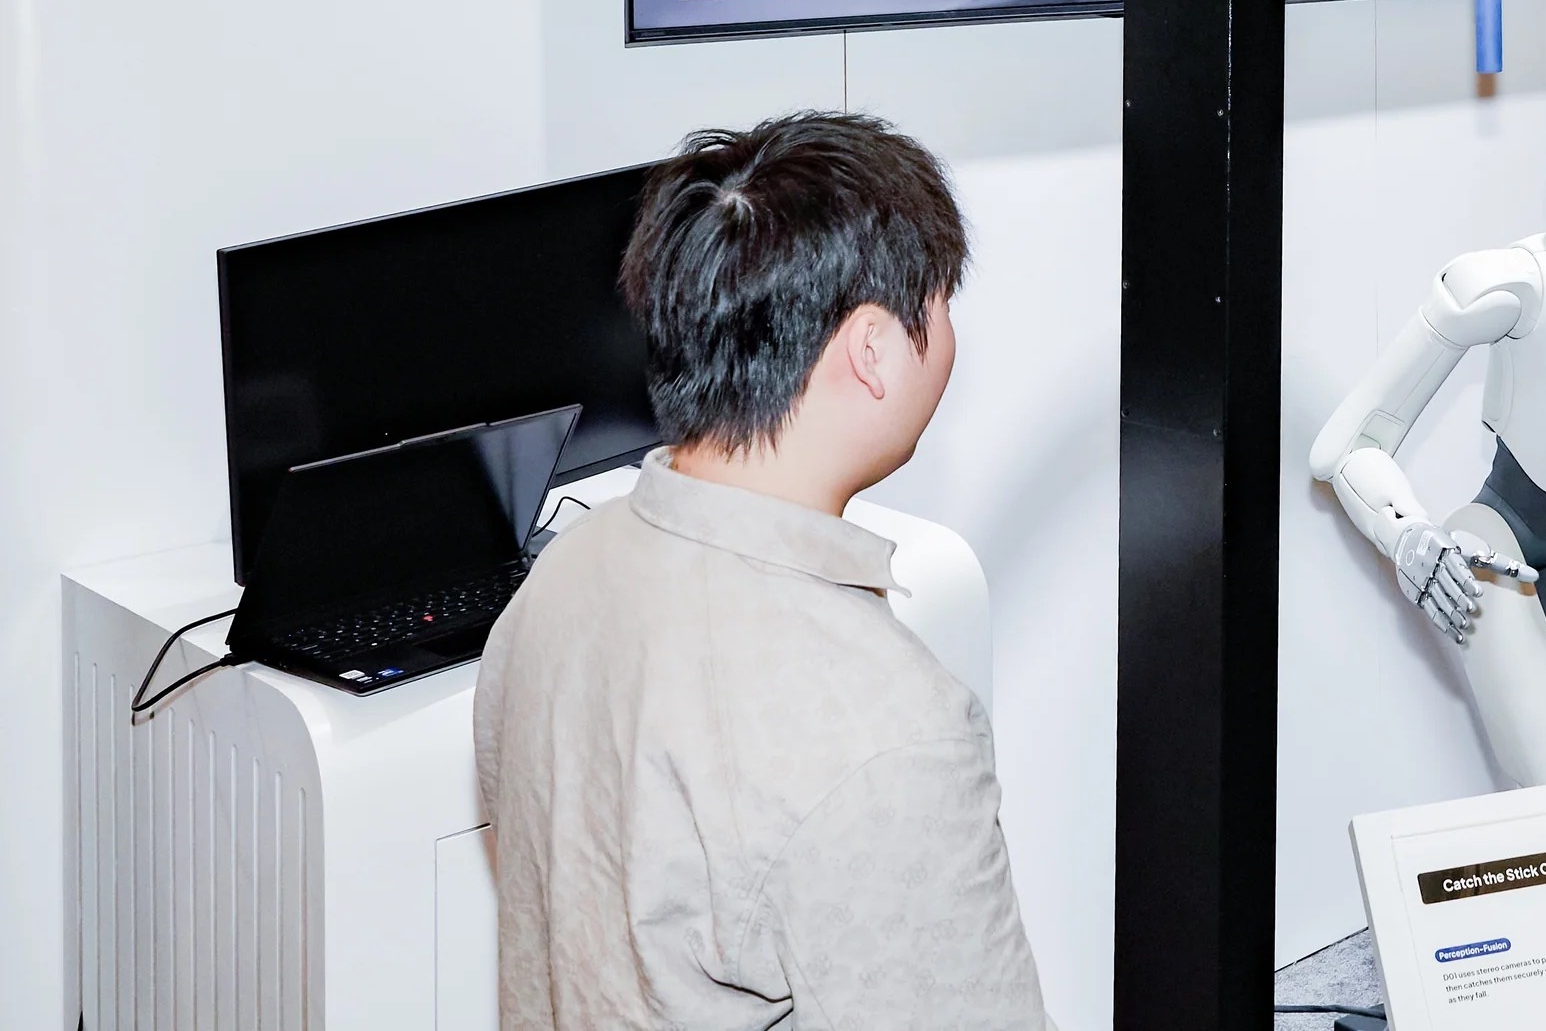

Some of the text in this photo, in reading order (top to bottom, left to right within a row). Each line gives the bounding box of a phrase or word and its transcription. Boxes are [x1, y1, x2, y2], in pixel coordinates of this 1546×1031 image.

[1443, 873, 1482, 892] Catch
[1483, 871, 1504, 885] the
[1506, 865, 1540, 881] Stick
[1438, 941, 1508, 960] Perception-Fusion
[1458, 971, 1475, 979] uses
[1476, 966, 1500, 975] stereo
[1500, 960, 1532, 971] cameras
[1446, 983, 1462, 992] then
[1463, 978, 1493, 989] catches
[1493, 974, 1513, 984] them
[1513, 968, 1544, 981] securely
[1448, 996, 1457, 1004] as
[1458, 993, 1474, 1004] they
